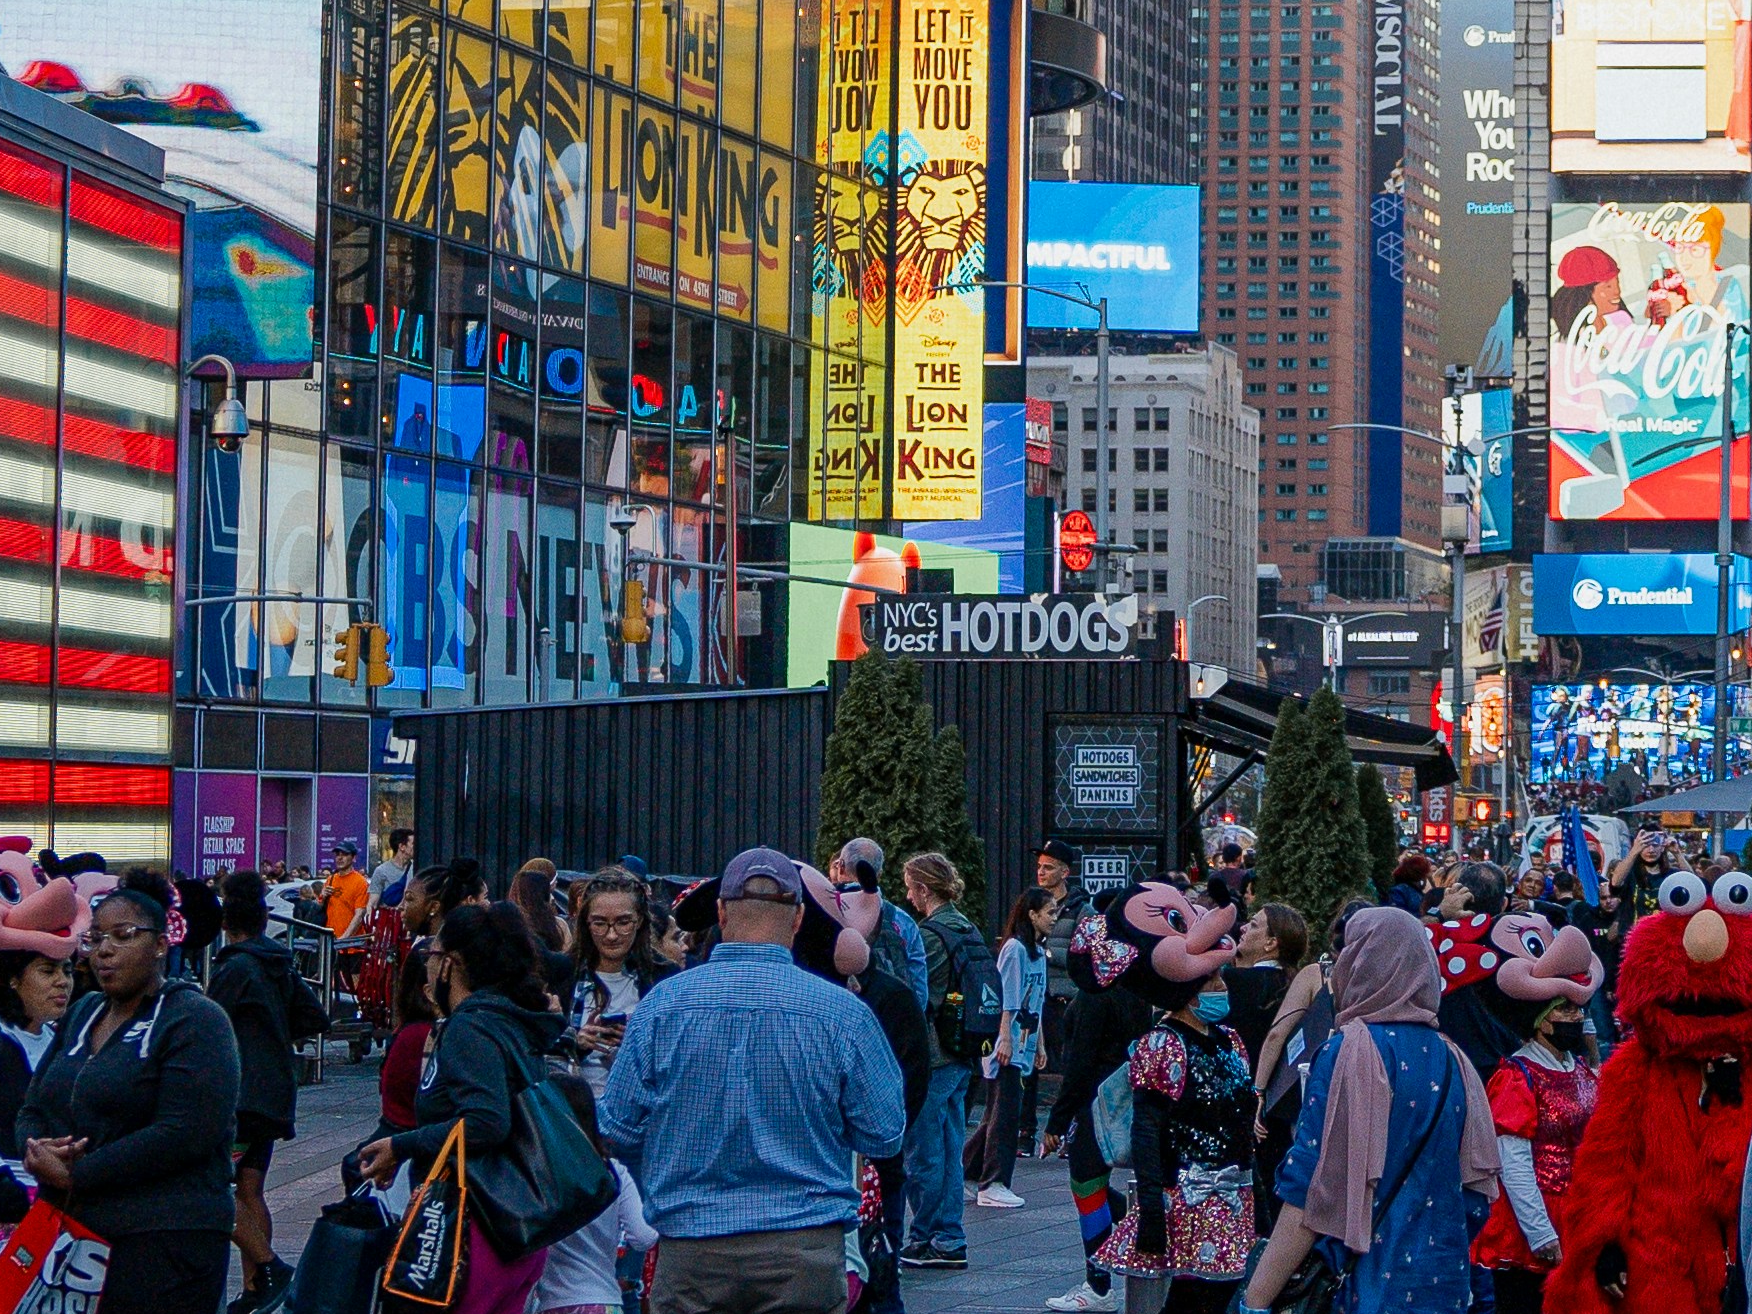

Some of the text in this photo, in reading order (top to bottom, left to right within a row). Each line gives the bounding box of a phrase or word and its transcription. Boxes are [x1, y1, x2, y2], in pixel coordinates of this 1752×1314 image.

[914, 8, 951, 43] LET
[1576, 2, 1727, 31] BESPOKE
[913, 47, 972, 81] MOVE
[913, 84, 972, 131] YOU
[601, 64, 779, 260] LION KING
[1587, 202, 1713, 242] Coca-Cola
[1027, 241, 1170, 272] MPACTFUL
[636, 260, 738, 306] ENTRANCE ON 45TH STREET
[919, 334, 958, 351] Disney
[914, 362, 961, 384] THE
[905, 395, 968, 432] LION
[898, 438, 976, 481] KING
[1607, 586, 1694, 605] Prudential
[884, 601, 938, 628] NYC's
[942, 601, 1130, 653] HOTDOGS
[884, 626, 939, 652] best
[1081, 751, 1129, 764] HOTDOGS
[1074, 769, 1137, 783] SANDWICHES
[1080, 789, 1129, 802] PANINIS
[203, 815, 235, 834] FLAGSHIP
[203, 837, 245, 854] RETAIL SPACE
[1087, 861, 1124, 875] BEER
[408, 1199, 445, 1290] Marshalls
